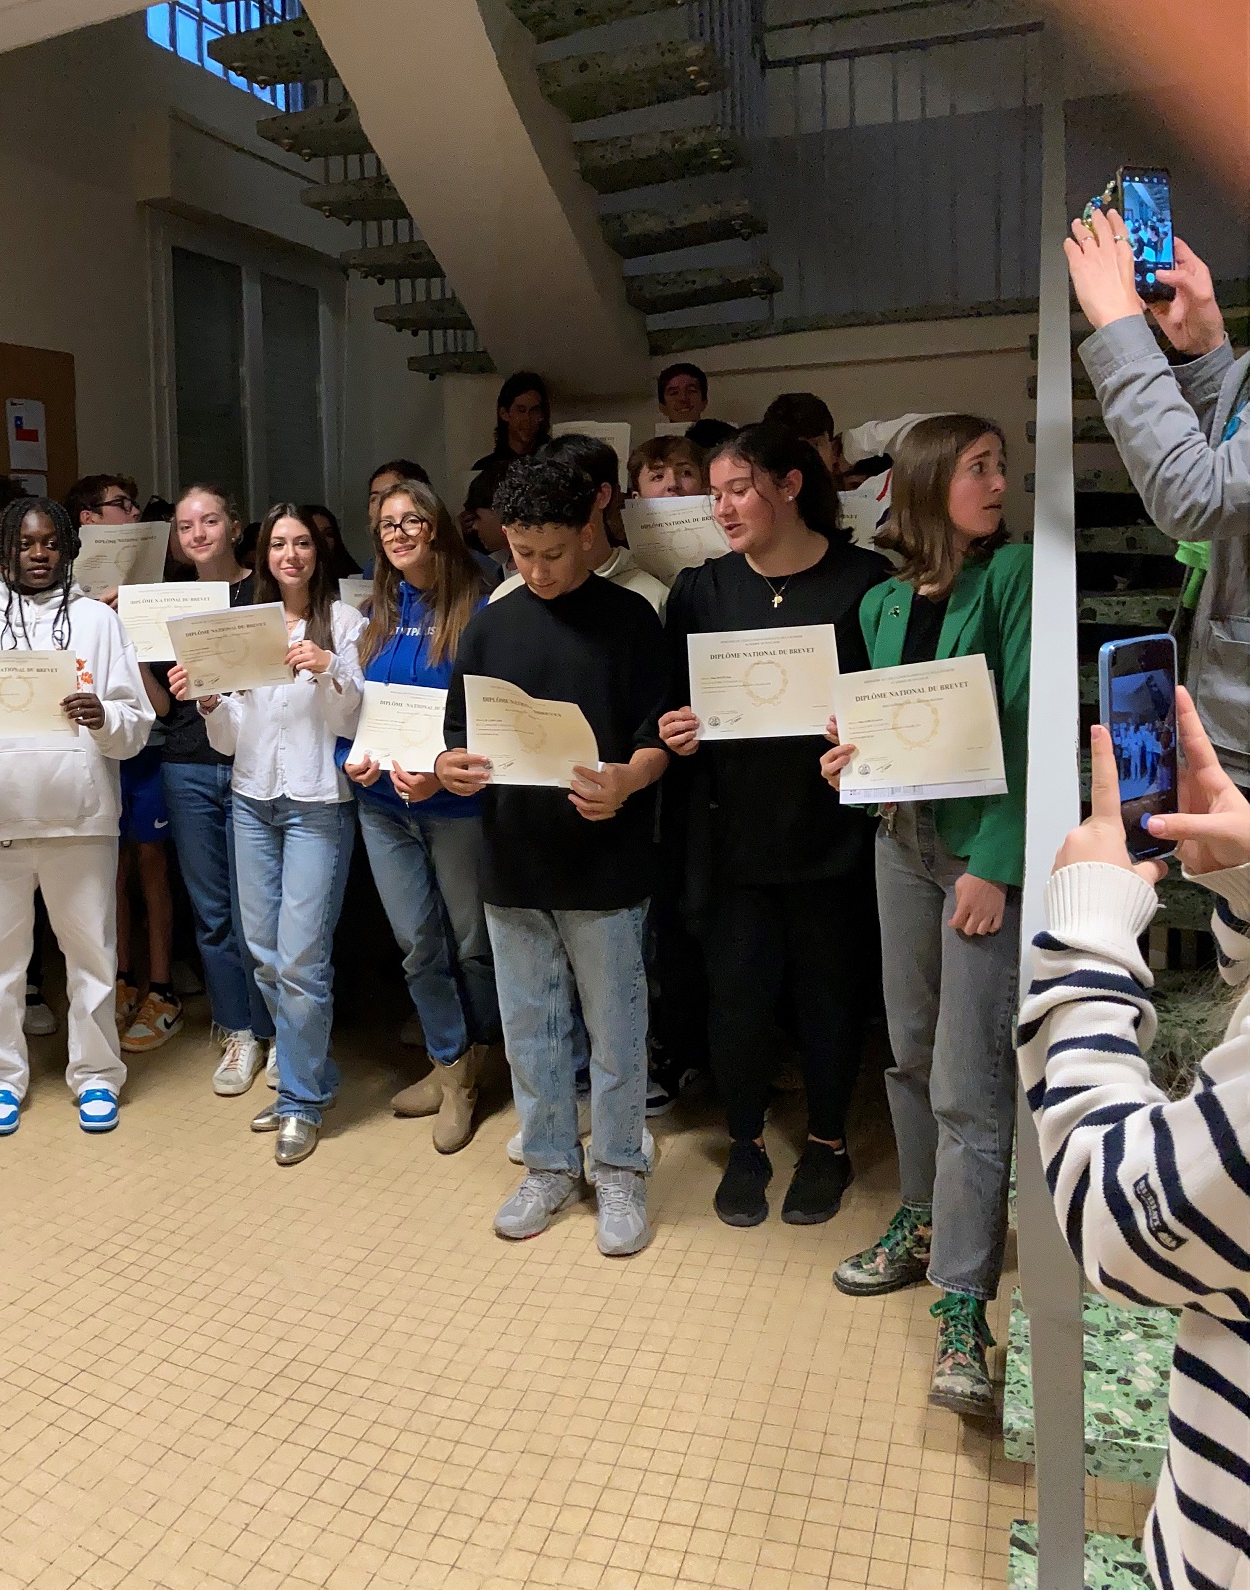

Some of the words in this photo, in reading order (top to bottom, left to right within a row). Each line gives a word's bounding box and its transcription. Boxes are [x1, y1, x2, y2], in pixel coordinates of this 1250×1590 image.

[710, 651, 741, 660] DIPLÔME
[743, 649, 777, 658] NATIONAL
[790, 647, 815, 655] BREVET
[855, 692, 887, 702] DIPLÔME
[889, 687, 927, 697] NATIONAL
[940, 681, 969, 691] BREVET
